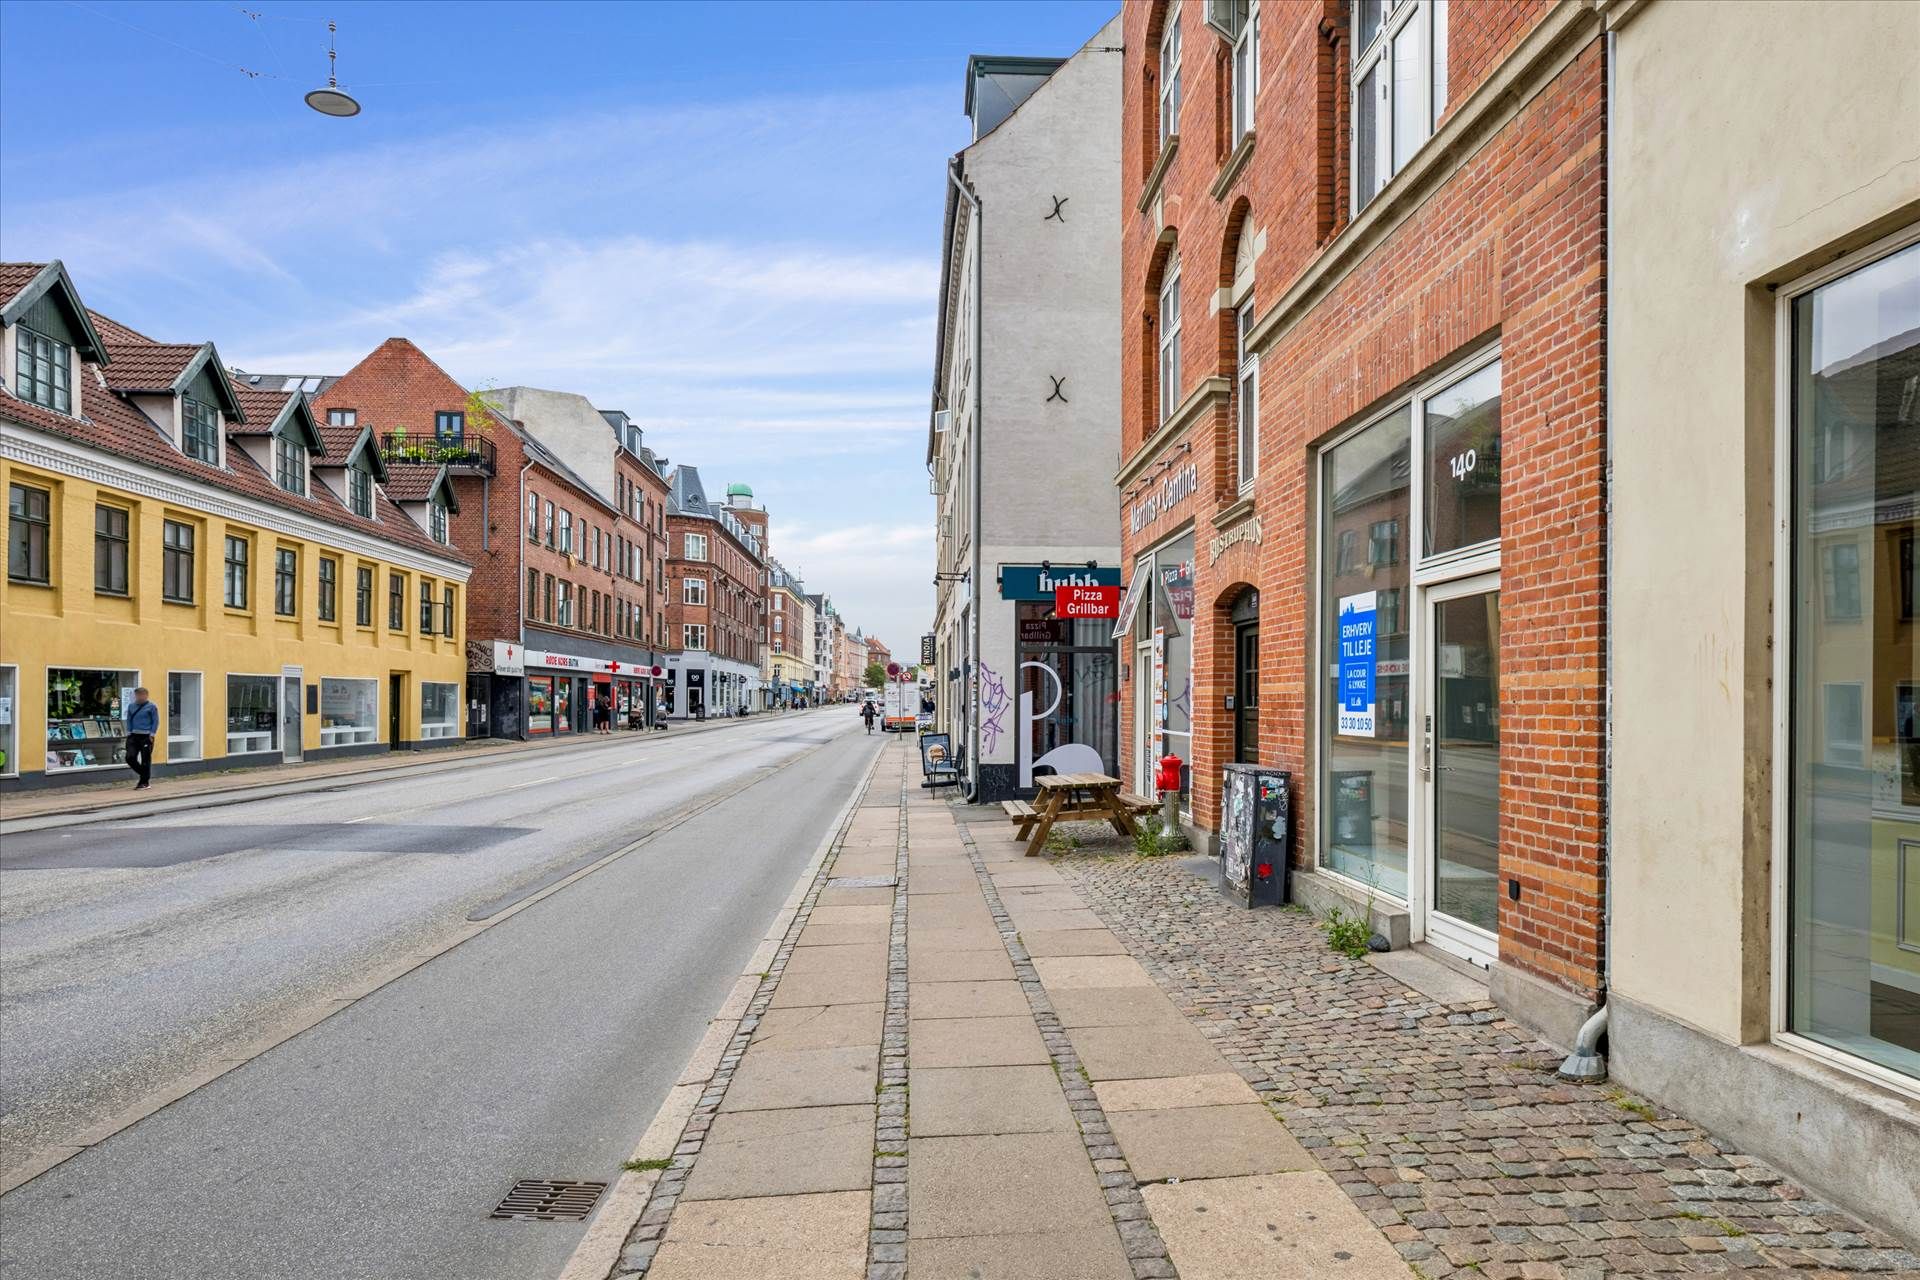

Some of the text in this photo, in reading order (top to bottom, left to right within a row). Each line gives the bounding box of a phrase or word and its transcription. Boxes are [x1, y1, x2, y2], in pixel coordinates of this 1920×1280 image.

[1450, 449, 1476, 482] 140
[1162, 462, 1197, 512] Cantina
[1165, 569, 1178, 584] Pizza
[1073, 589, 1103, 601] Pizza
[1067, 602, 1109, 615] Grillbar
[1342, 620, 1373, 639] ERHVERV
[1342, 639, 1372, 657] TIL LEJE
[1353, 668, 1367, 678] COUR
[1340, 717, 1373, 731] 33 30 10 50
